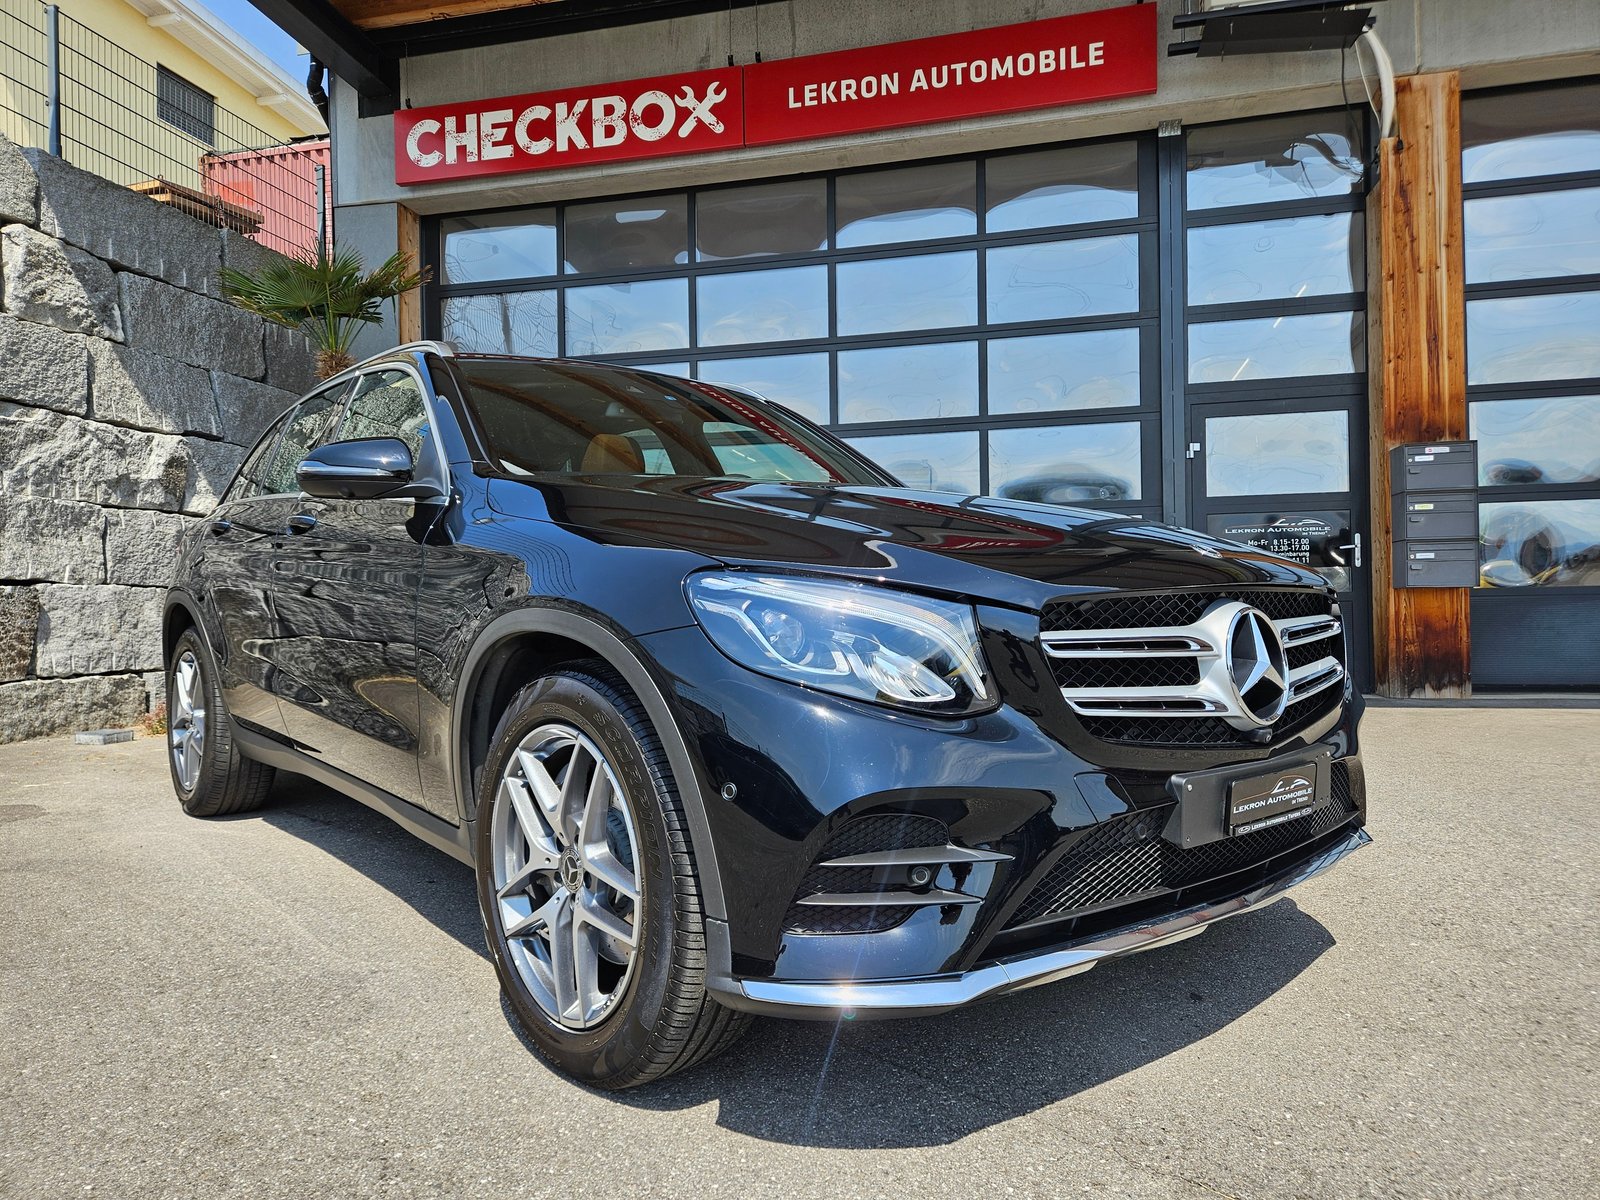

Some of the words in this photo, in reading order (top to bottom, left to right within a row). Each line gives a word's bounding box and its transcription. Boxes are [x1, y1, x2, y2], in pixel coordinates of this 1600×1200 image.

[788, 73, 901, 109] LEKRON
[909, 41, 1106, 93] AUTOMOBILE
[592, 709, 665, 880] SCORPION
[1233, 799, 1266, 814] LEKRON
[1267, 787, 1313, 805] AUTOMOBILE
